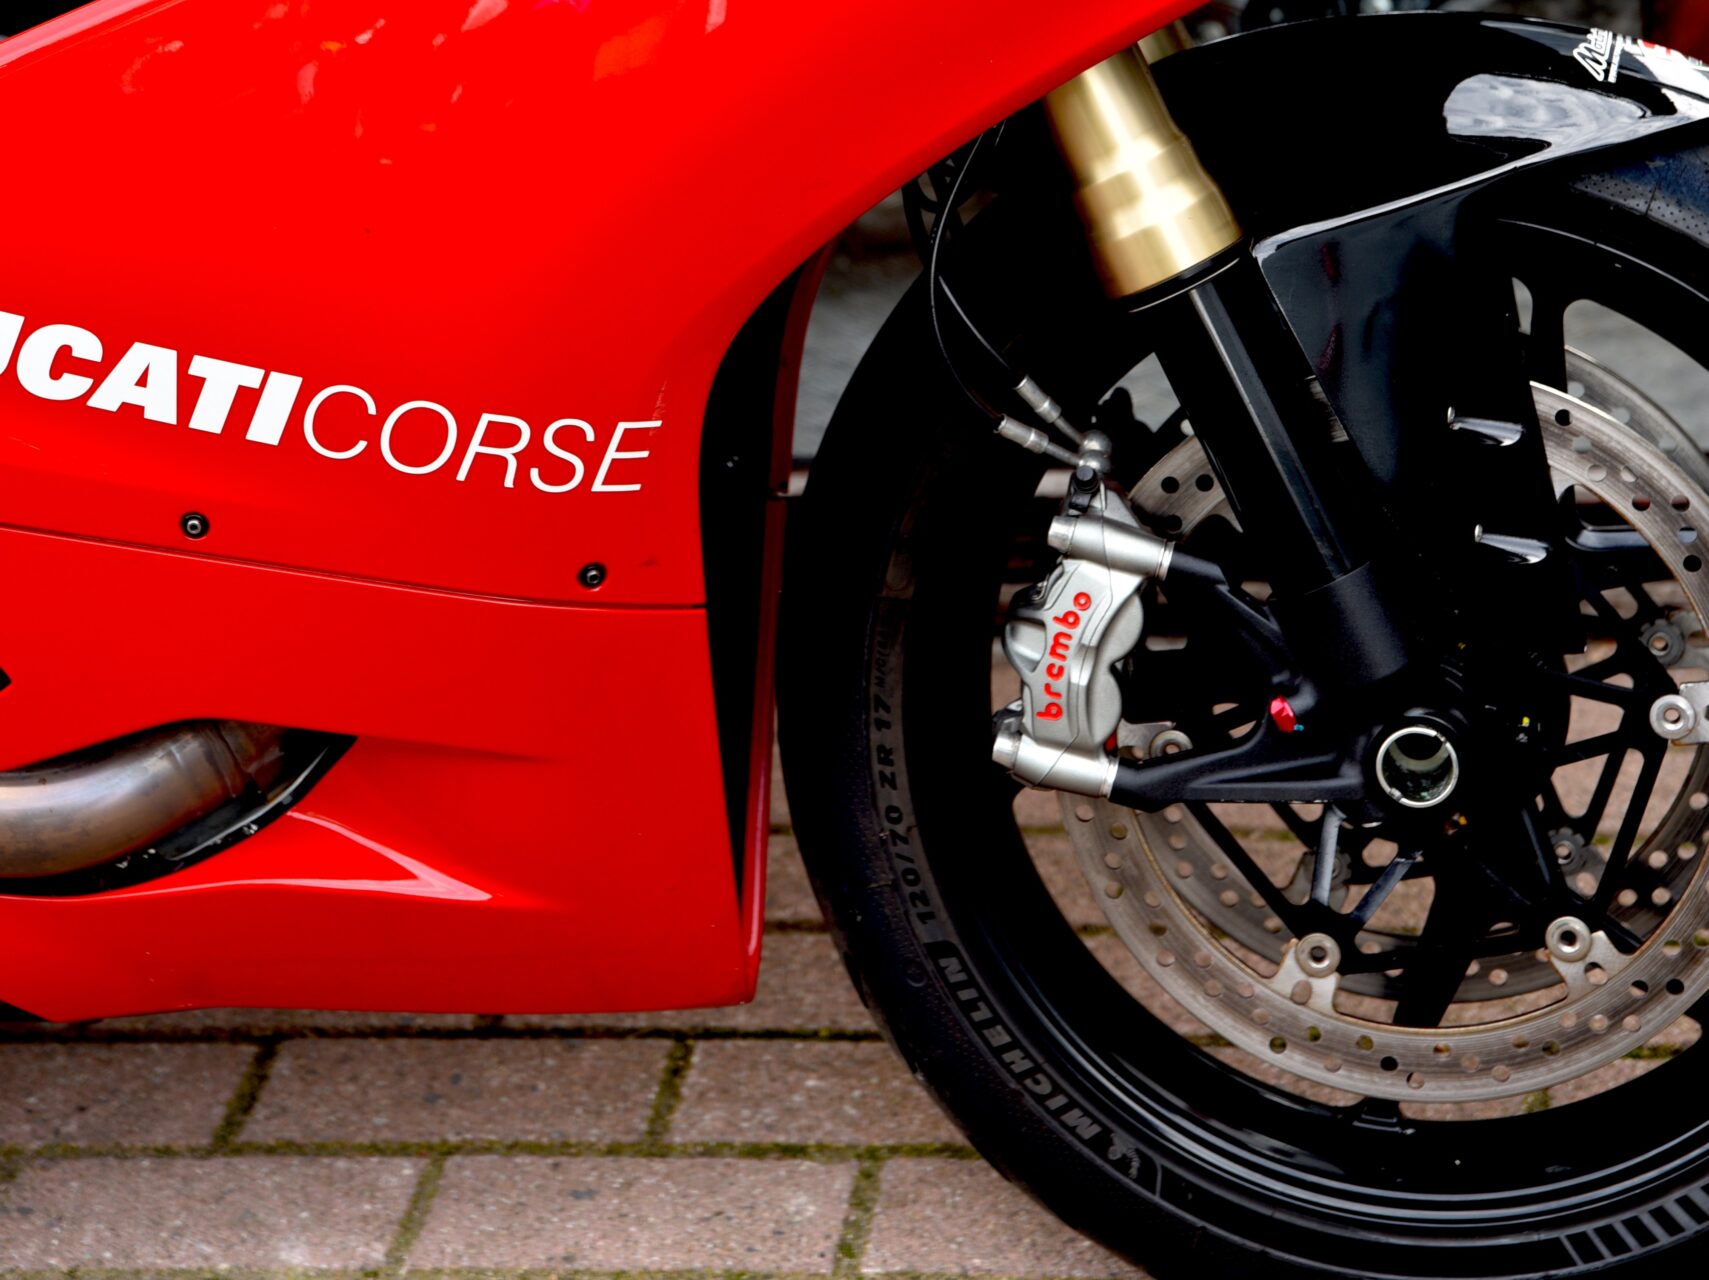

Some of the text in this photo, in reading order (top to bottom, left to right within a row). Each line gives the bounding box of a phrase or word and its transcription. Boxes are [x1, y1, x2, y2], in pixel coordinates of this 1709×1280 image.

[874, 695, 892, 731] 17
[1036, 591, 1092, 721] brembo
[877, 744, 897, 790] ZR
[885, 805, 935, 924] 120/70
[938, 955, 1104, 1141] MICHELIN
